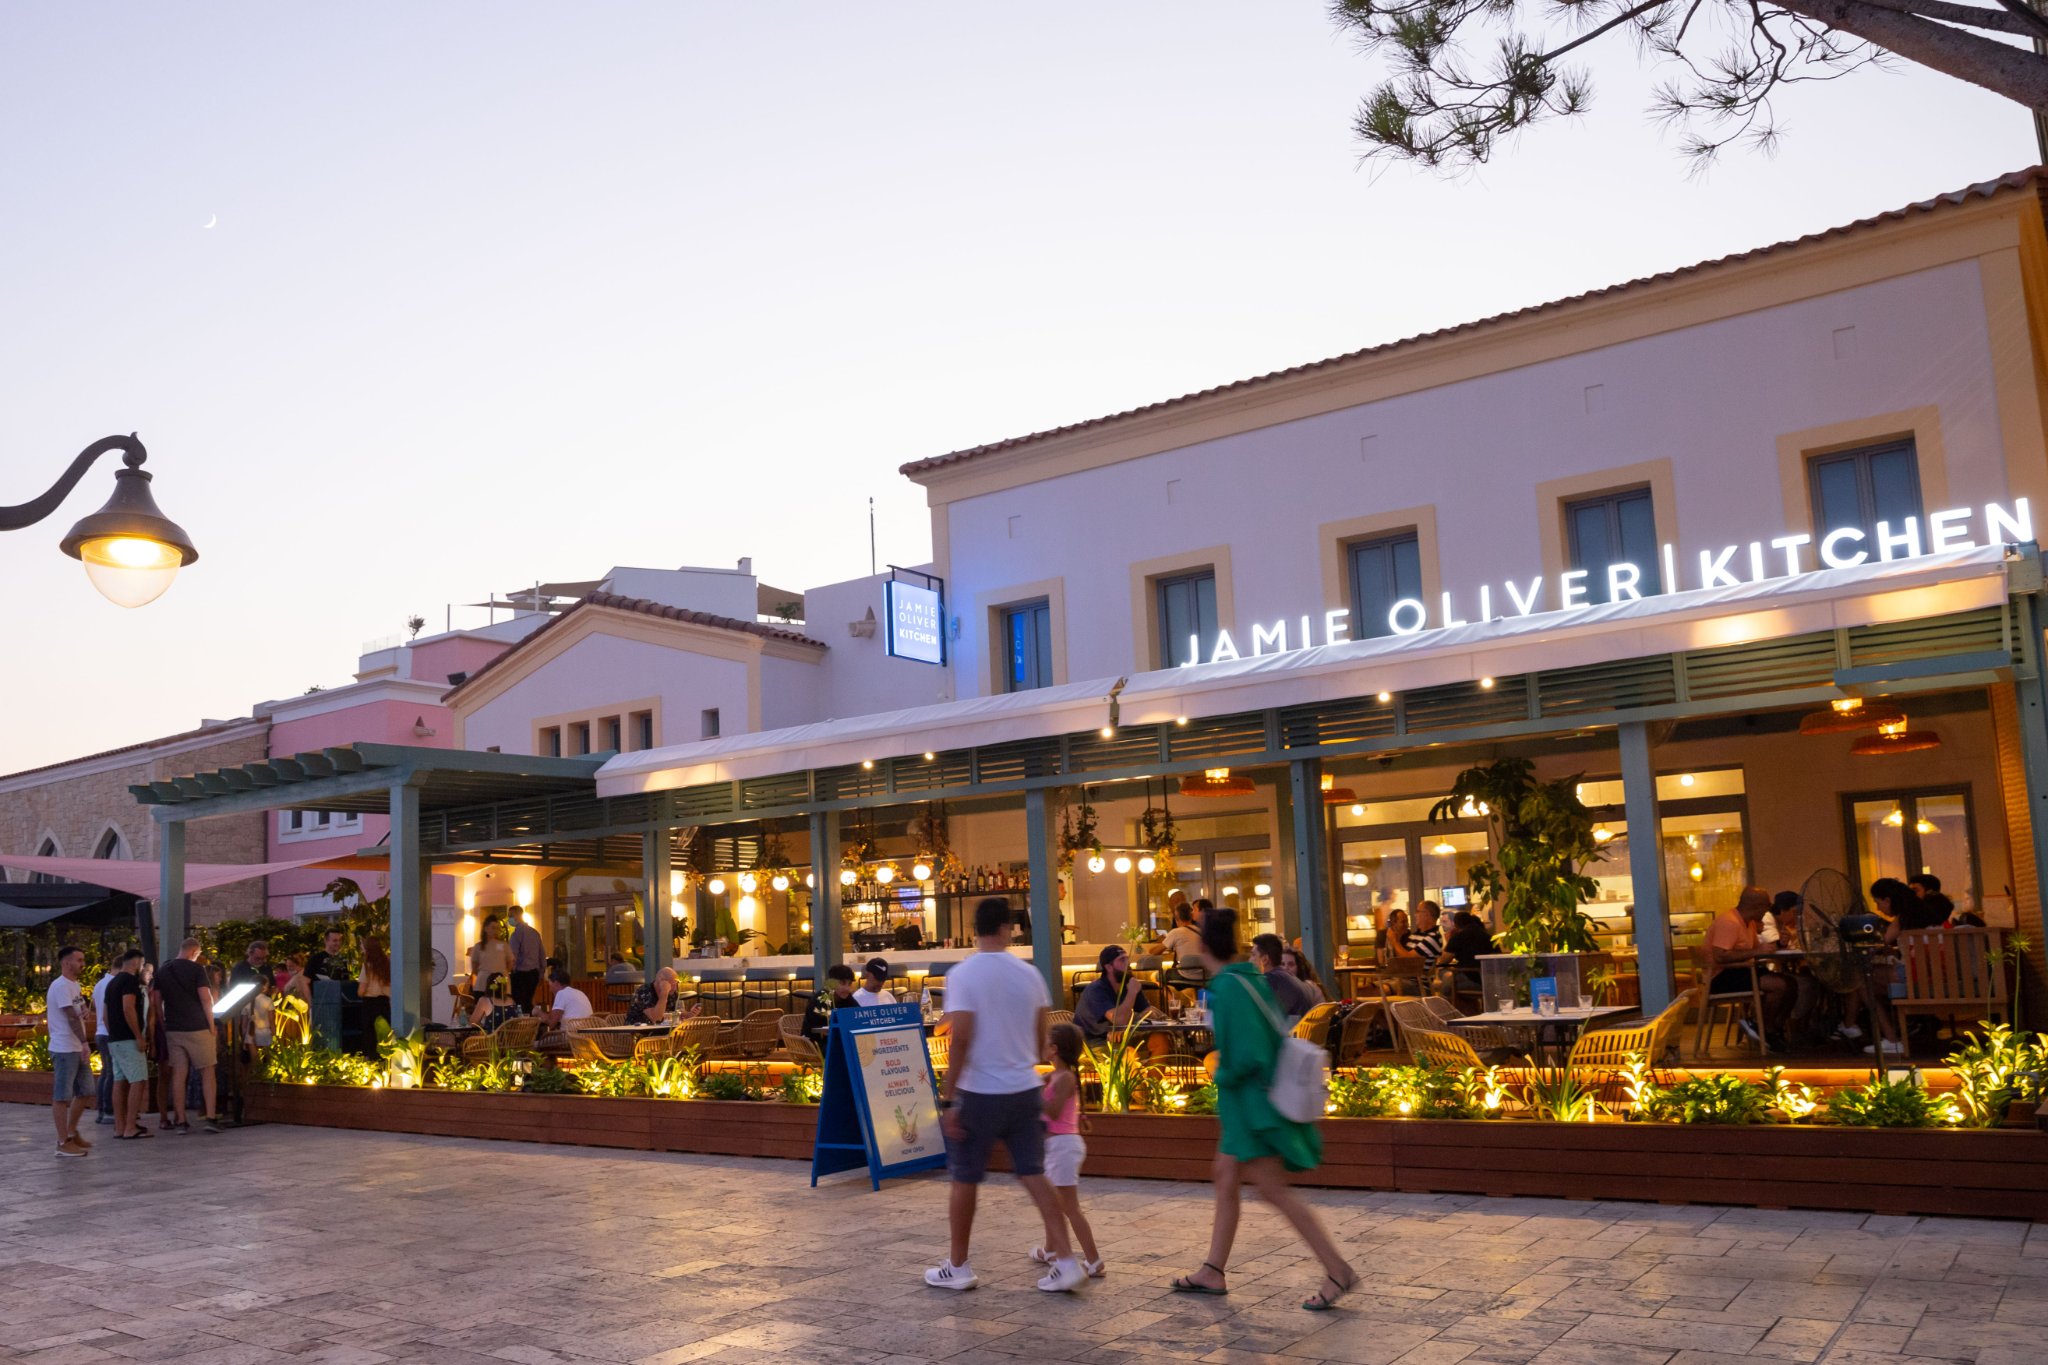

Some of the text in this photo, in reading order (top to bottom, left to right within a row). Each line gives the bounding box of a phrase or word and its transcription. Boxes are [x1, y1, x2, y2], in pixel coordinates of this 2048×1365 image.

[1180, 497, 2035, 668] JAMIE OLIVER KITCHEN
[899, 600, 936, 617] JAMIE
[899, 612, 937, 630] OLIVER
[899, 628, 937, 645] KITCHEN
[854, 1006, 908, 1019] JAMIE OLIVER
[869, 1017, 896, 1026] KITCHEN
[879, 1038, 898, 1046] FRESH
[872, 1044, 910, 1055] INGREDIENTS
[885, 1059, 901, 1067] BOLD
[881, 1065, 910, 1076] FLAVOURS
[887, 1080, 909, 1088] ALWAYS
[884, 1086, 915, 1097] DELICIOUS
